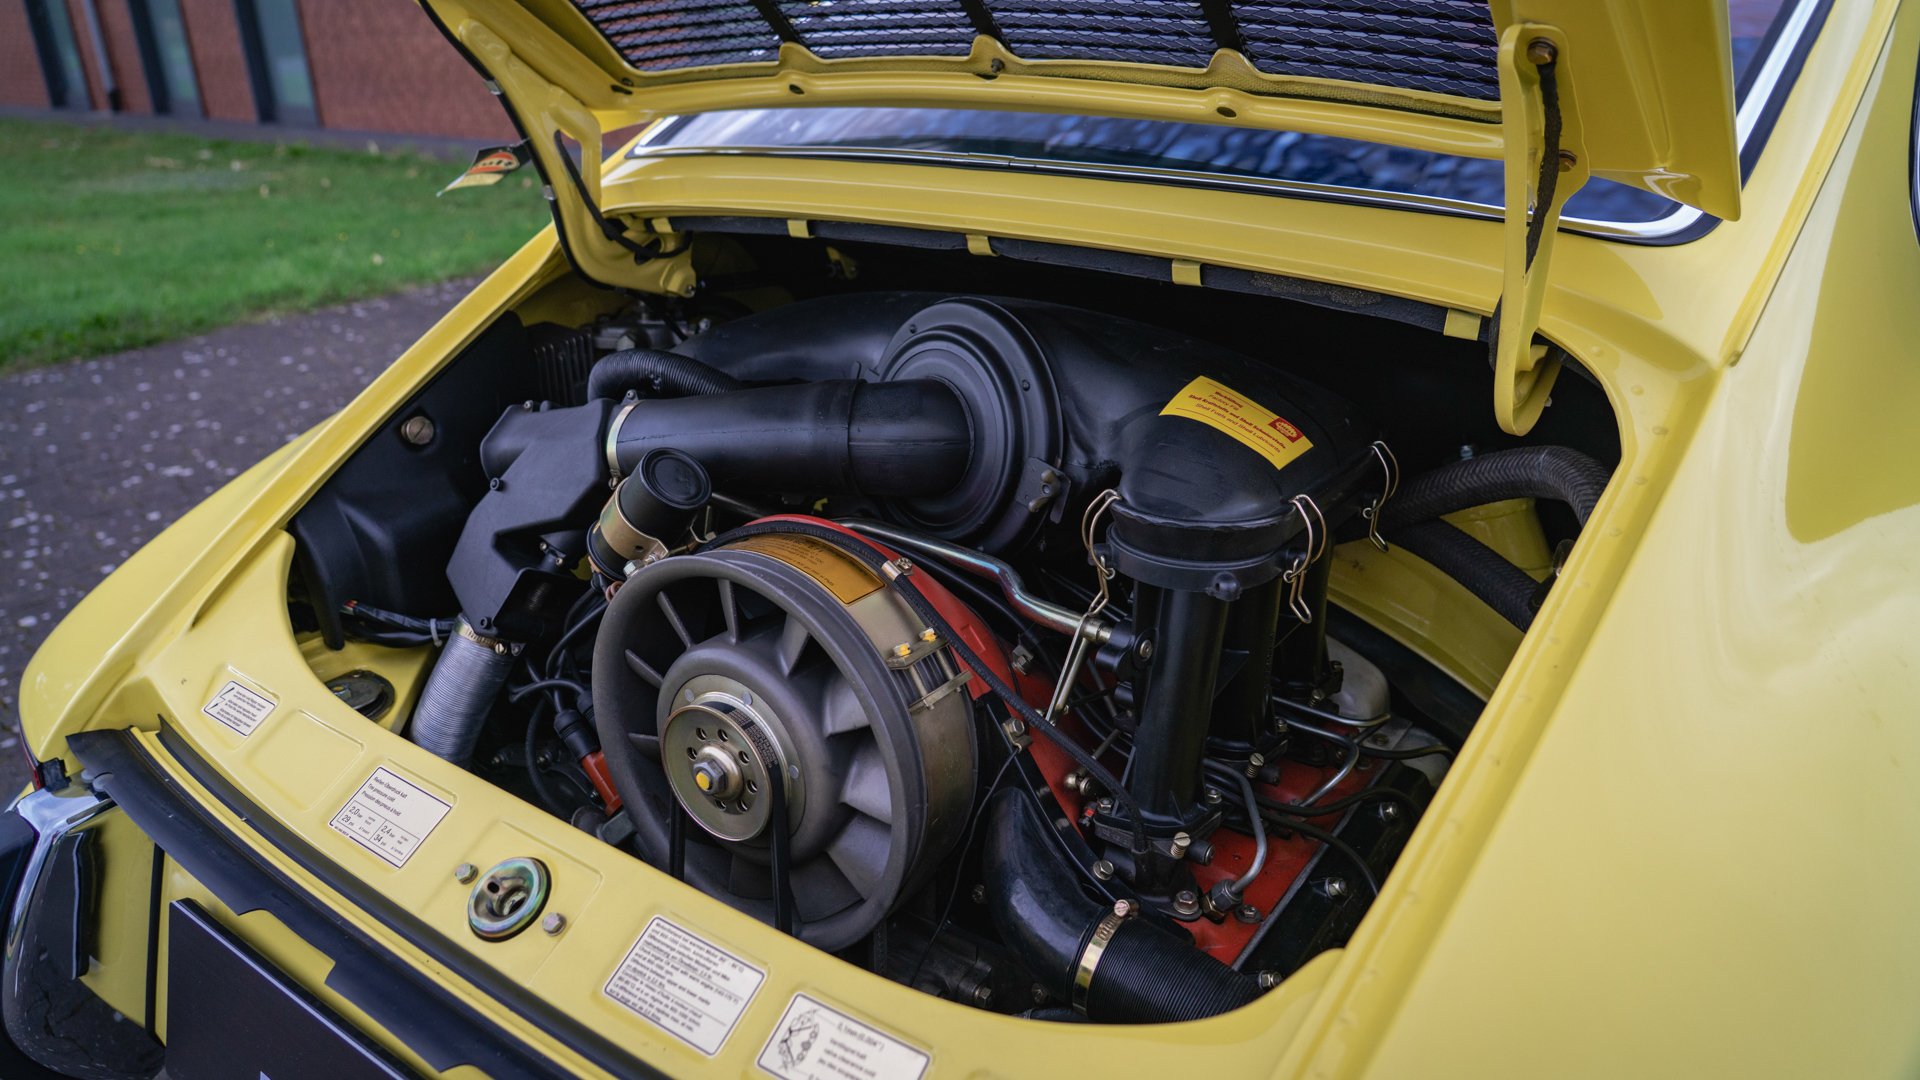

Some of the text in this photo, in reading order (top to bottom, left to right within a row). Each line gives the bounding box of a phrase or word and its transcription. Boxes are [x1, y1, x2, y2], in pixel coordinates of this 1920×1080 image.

[1240, 417, 1253, 428] Shell
[1239, 423, 1253, 434] Shell
[348, 806, 359, 815] 2,0
[341, 814, 351, 822] 29
[380, 825, 391, 834] 2,4
[373, 834, 382, 842] 34
